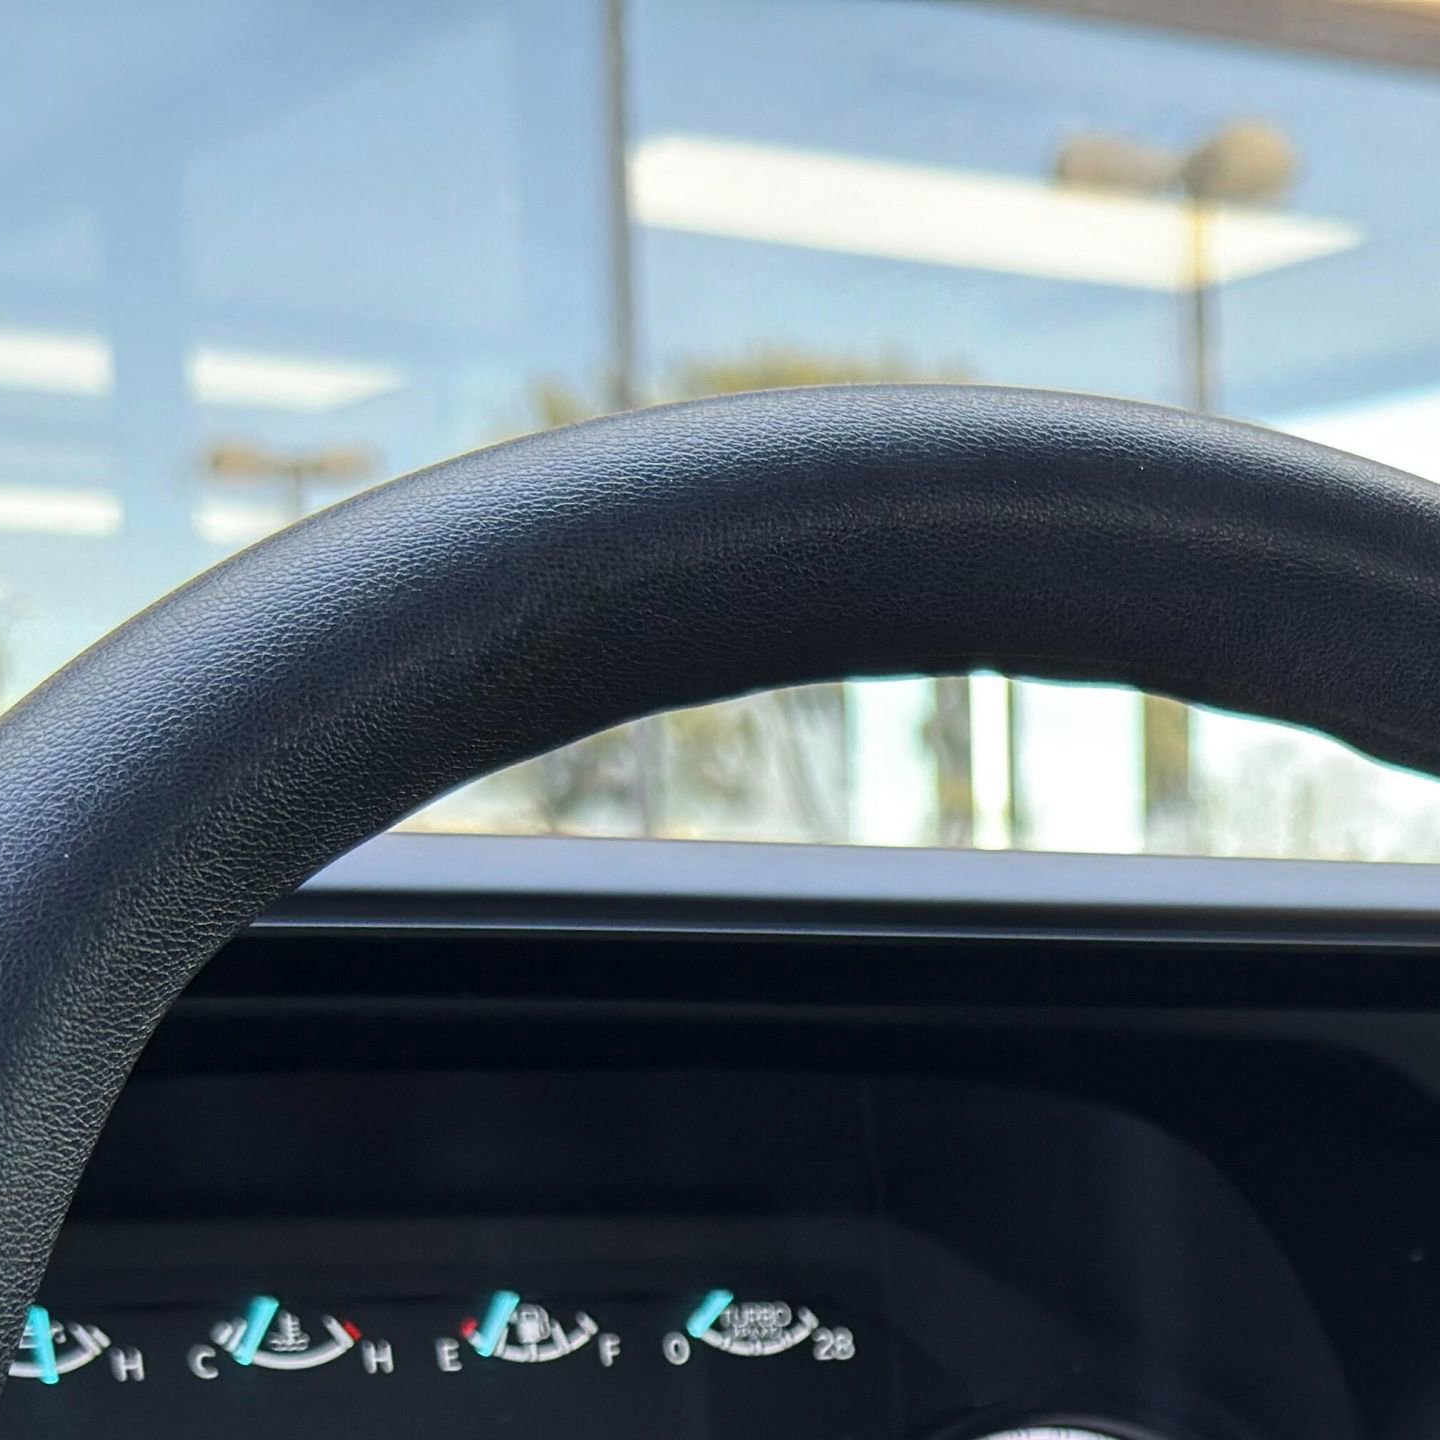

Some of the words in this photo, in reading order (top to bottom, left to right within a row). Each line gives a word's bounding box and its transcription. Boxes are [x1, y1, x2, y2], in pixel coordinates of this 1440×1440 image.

[362, 1339, 394, 1374] H
[434, 1337, 463, 1372] E
[597, 1333, 621, 1367] F
[812, 1326, 856, 1360] 28
[109, 1346, 145, 1382] H
[187, 1344, 219, 1380] C
